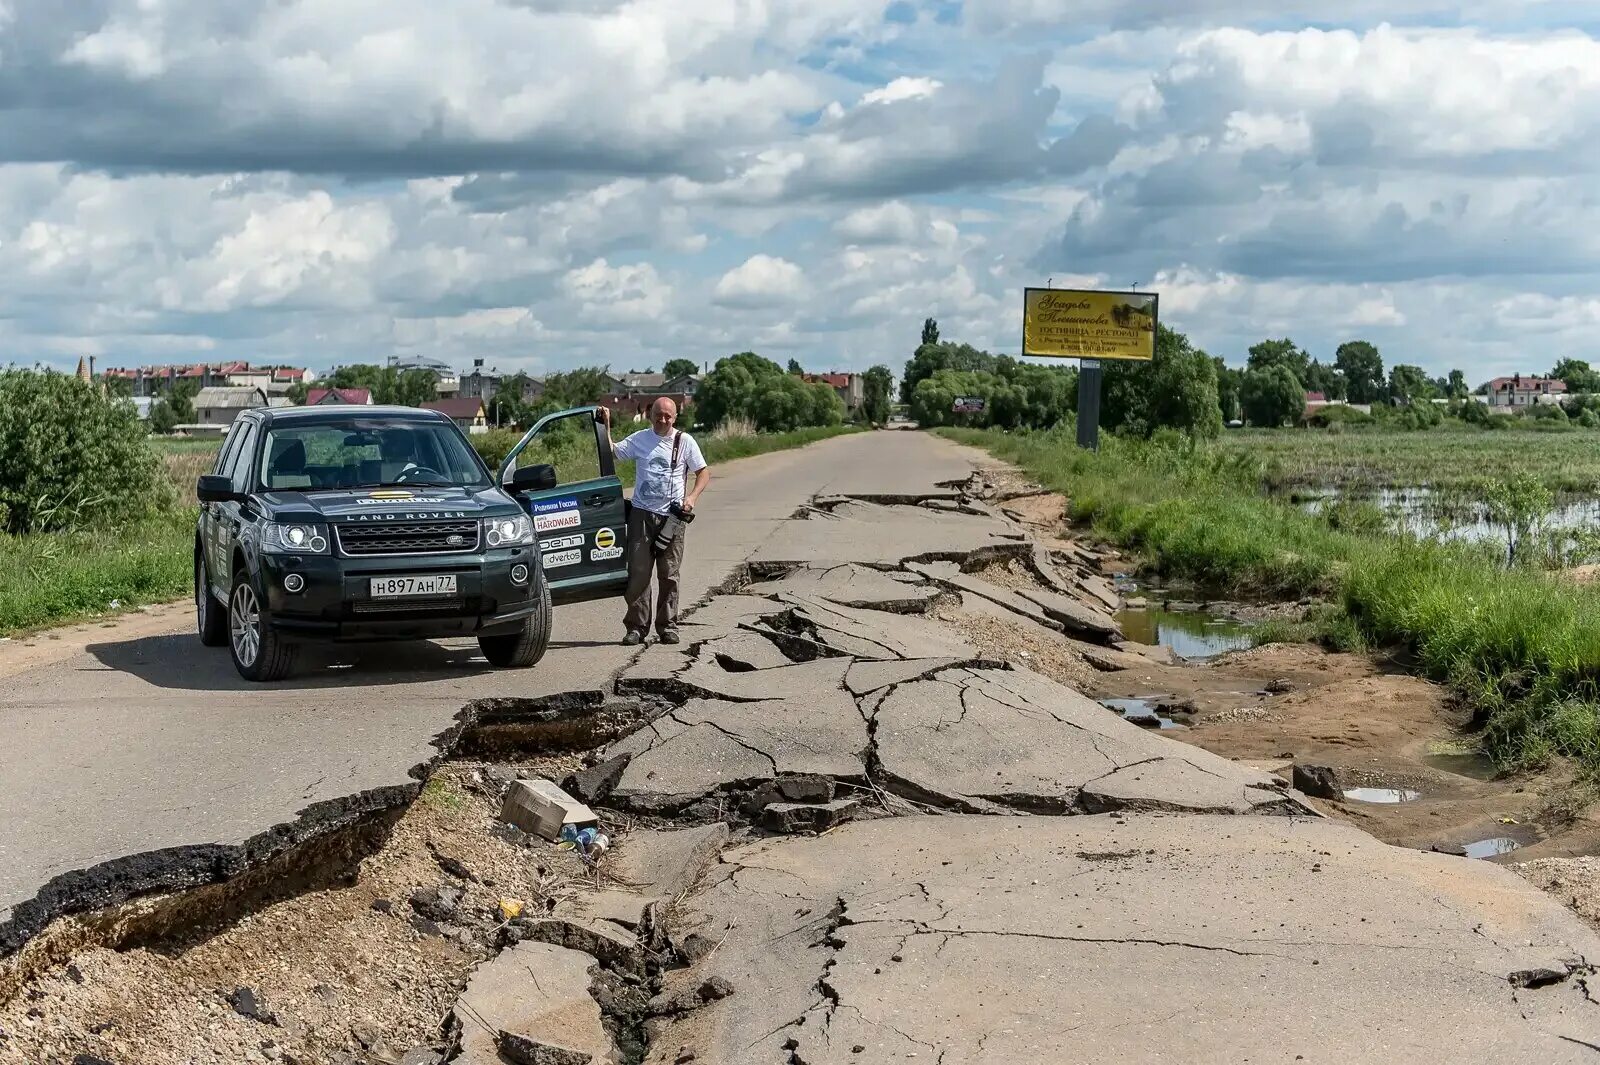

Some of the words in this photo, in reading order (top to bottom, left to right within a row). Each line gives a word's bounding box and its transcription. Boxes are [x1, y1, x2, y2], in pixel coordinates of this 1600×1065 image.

[1038, 295, 1091, 314] Усадьба
[1039, 327, 1089, 336] ГОСТИНИЦА
[1095, 329, 1139, 337] РЕСТОРАН
[538, 516, 578, 529] HARDWARE
[438, 577, 452, 587] 77
